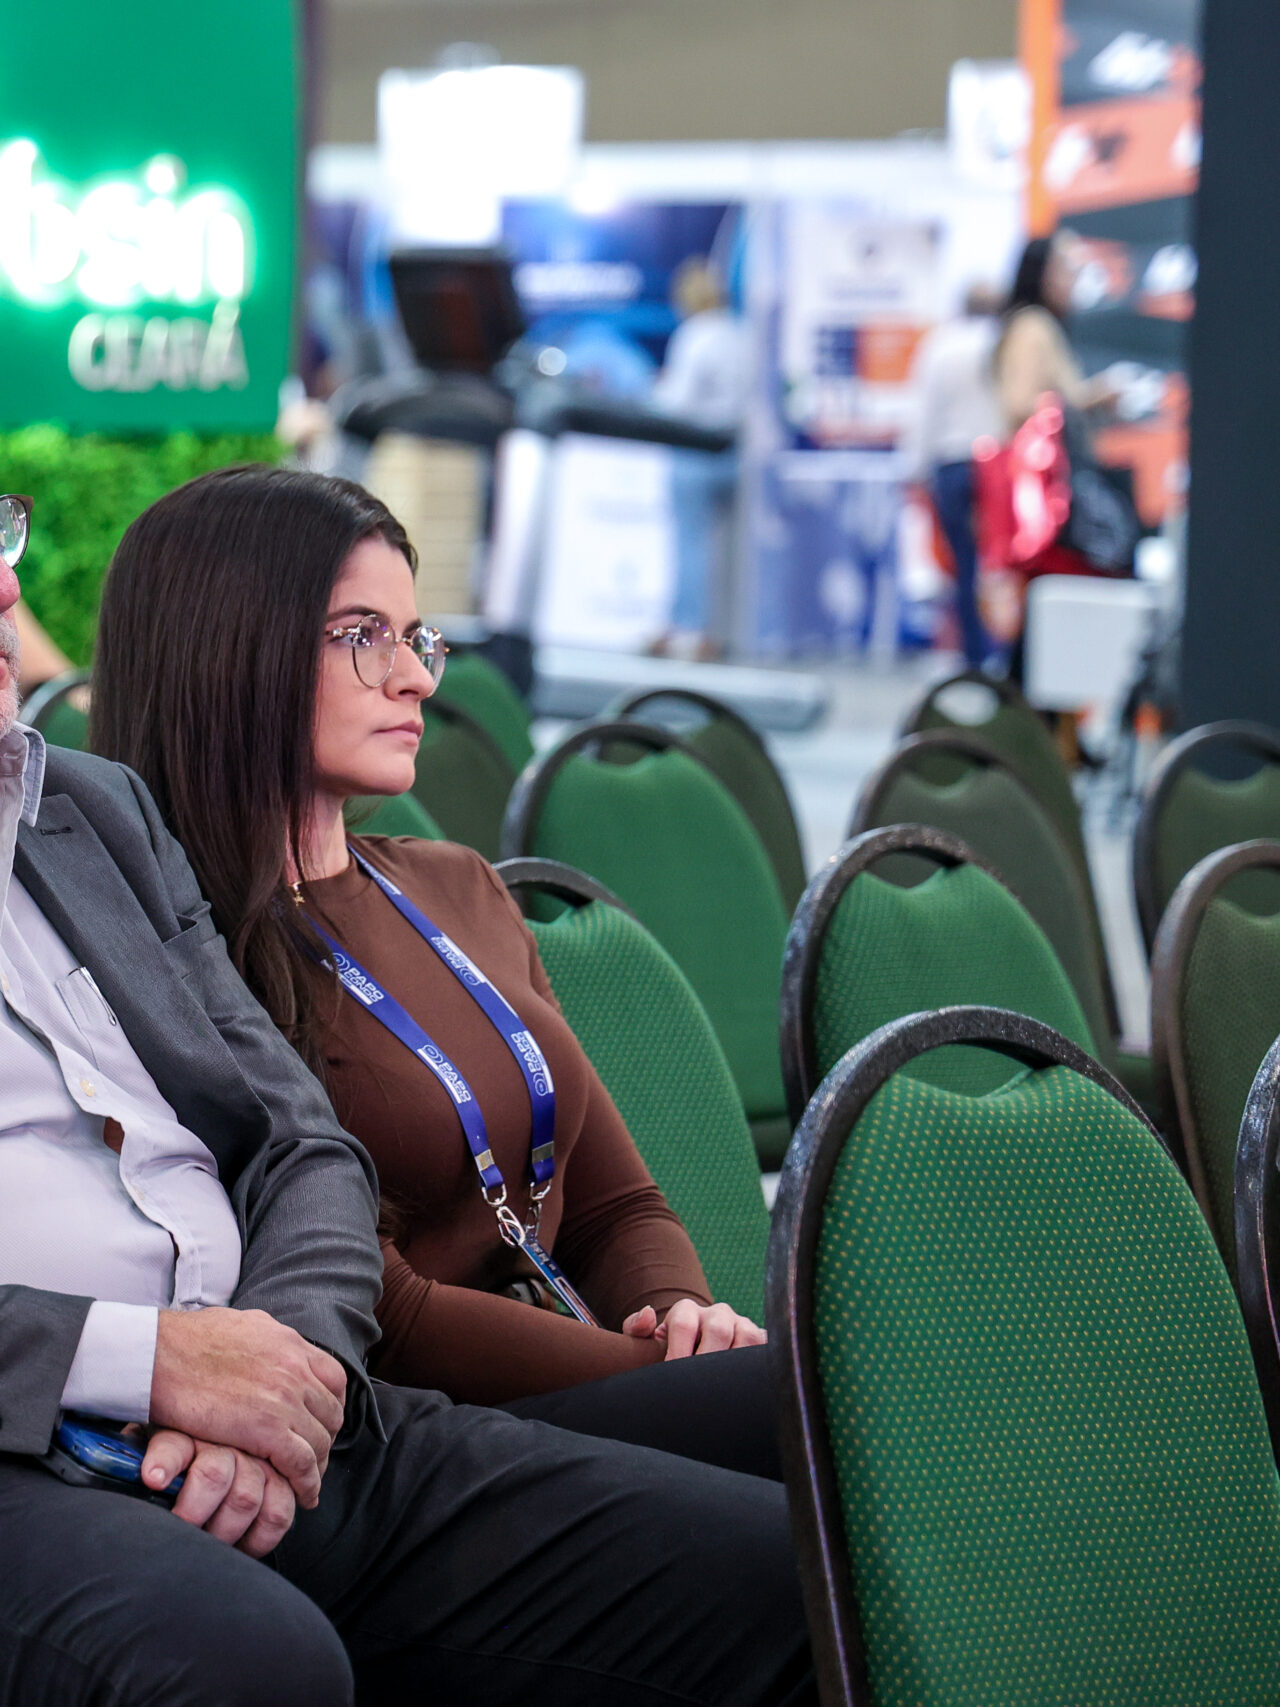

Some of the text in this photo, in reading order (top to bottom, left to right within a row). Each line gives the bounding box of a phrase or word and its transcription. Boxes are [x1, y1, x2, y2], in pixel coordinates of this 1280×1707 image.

[344, 971, 379, 1002] CONDO
[349, 967, 384, 1000] PAPO
[510, 1033, 537, 1073] PAPO
[442, 1062, 472, 1101] PAPO
